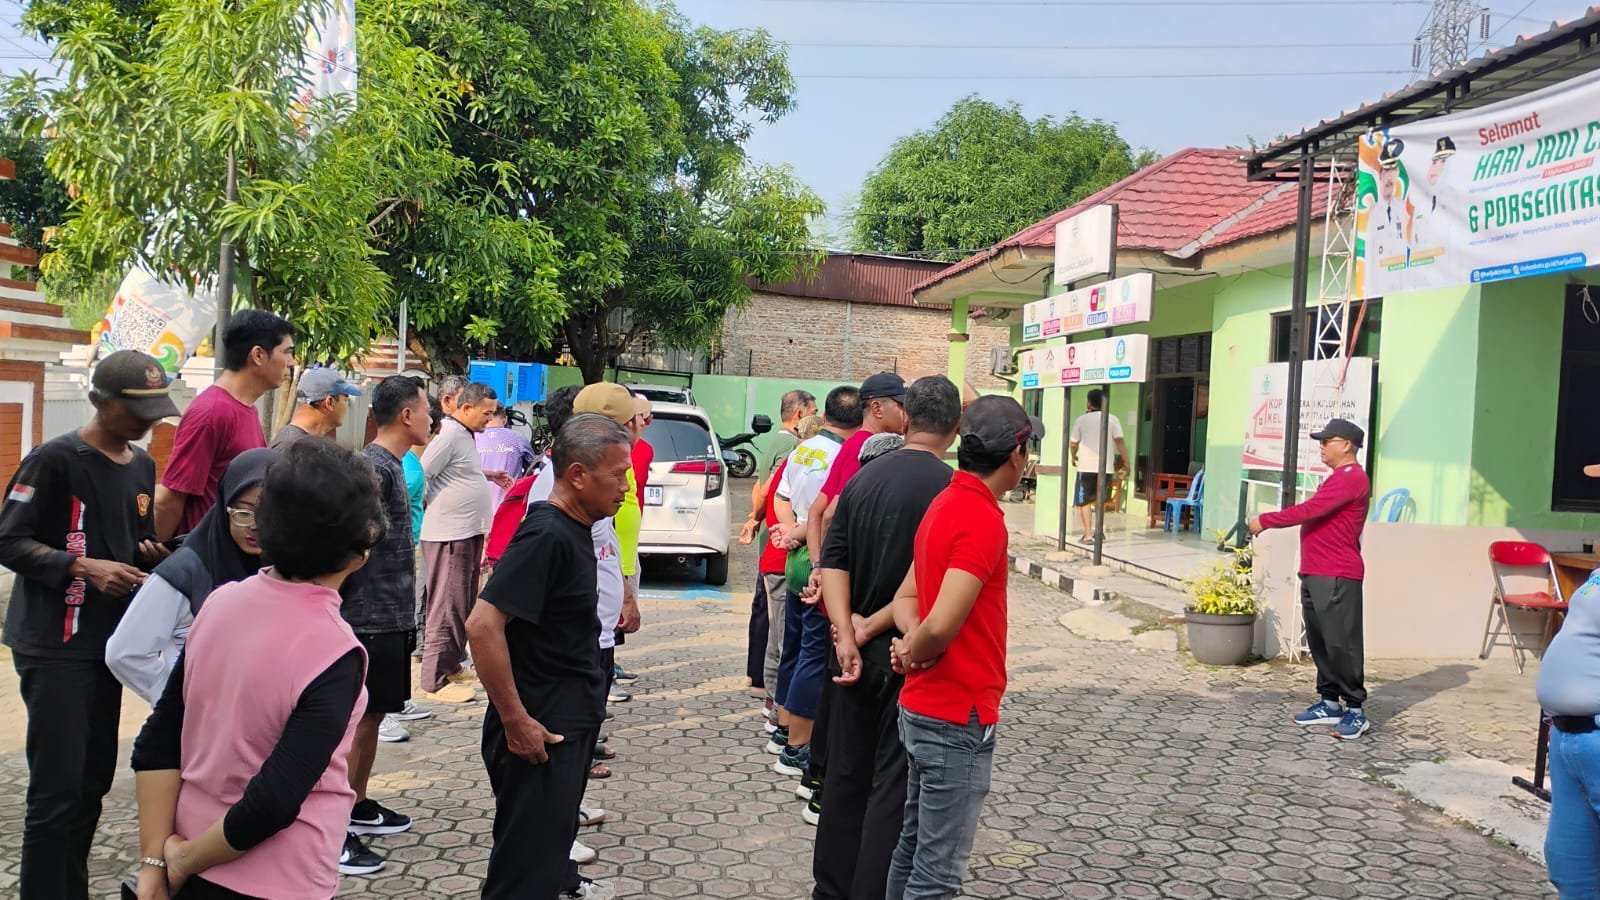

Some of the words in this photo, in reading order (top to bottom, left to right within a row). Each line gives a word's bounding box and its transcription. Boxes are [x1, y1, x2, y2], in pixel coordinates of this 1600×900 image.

[1472, 143, 1525, 181] HARI
[1526, 127, 1579, 169] JADI
[1478, 111, 1541, 146] Selamat
[1484, 174, 1600, 230] PORSENITA
